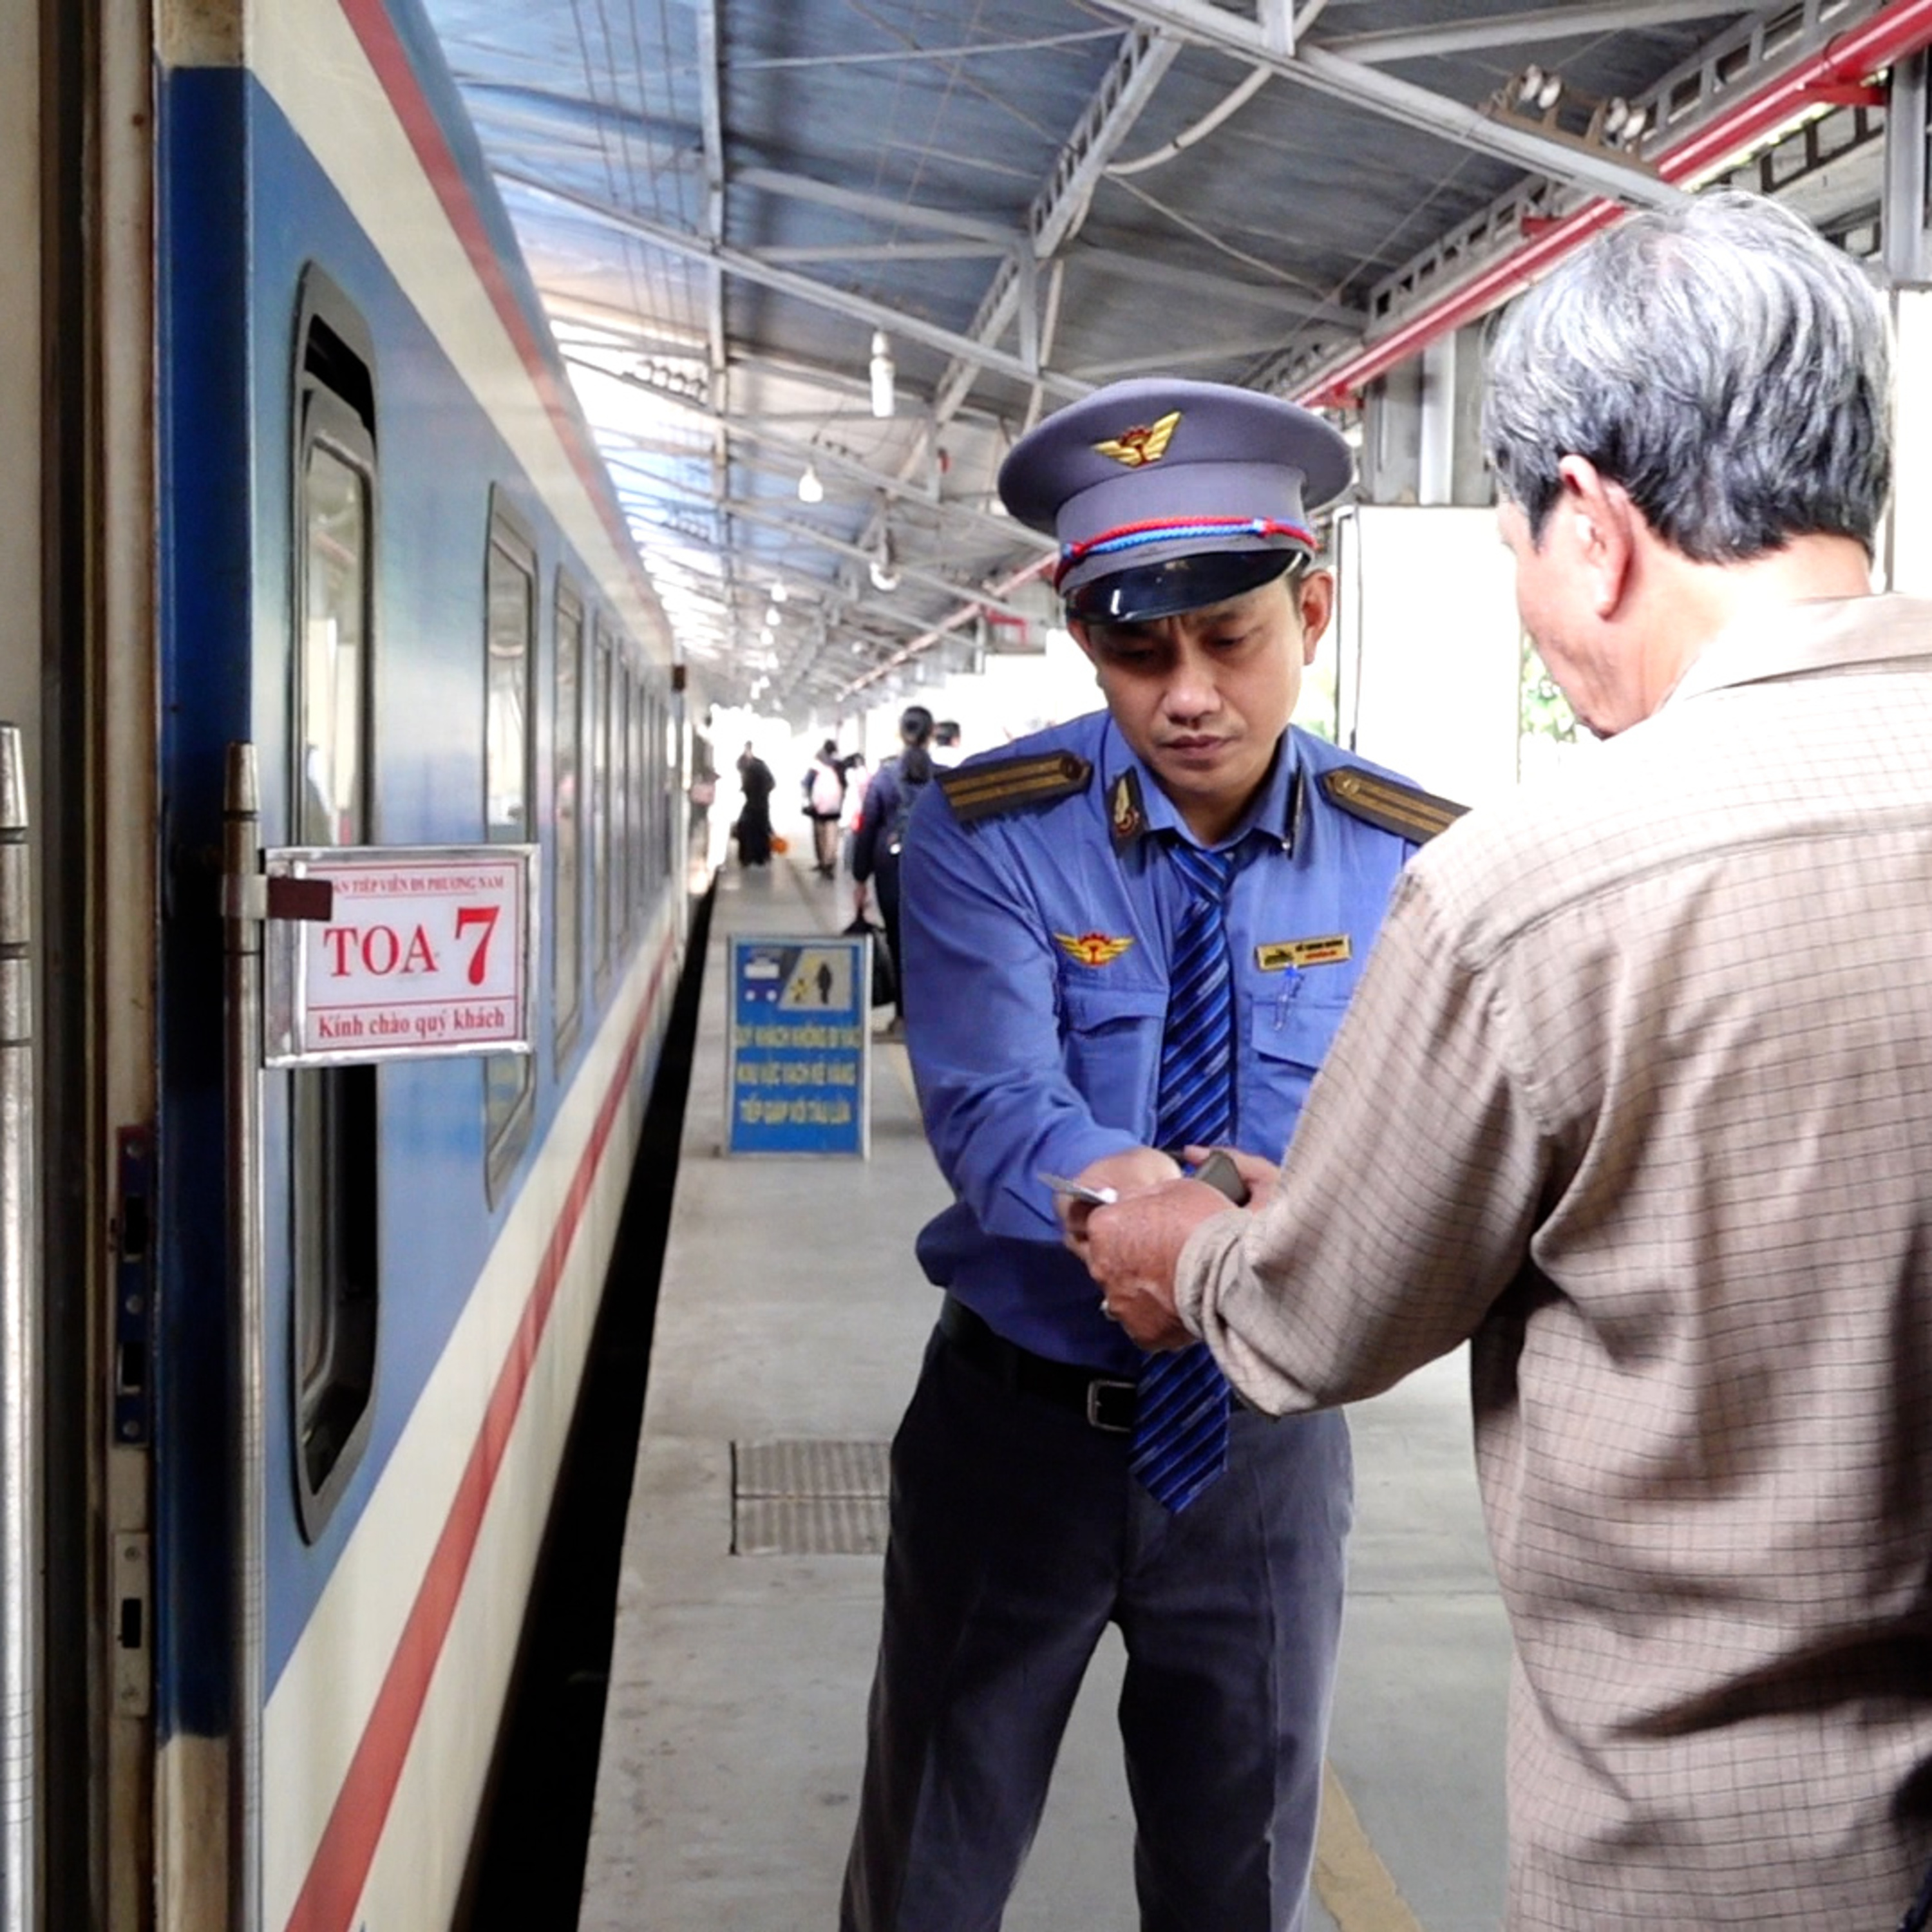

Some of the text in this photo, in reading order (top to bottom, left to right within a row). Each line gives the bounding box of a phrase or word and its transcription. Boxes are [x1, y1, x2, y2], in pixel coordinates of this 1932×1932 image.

[324, 905, 500, 986] TOA 7
[319, 1006, 505, 1038] Kính chào quý khách
